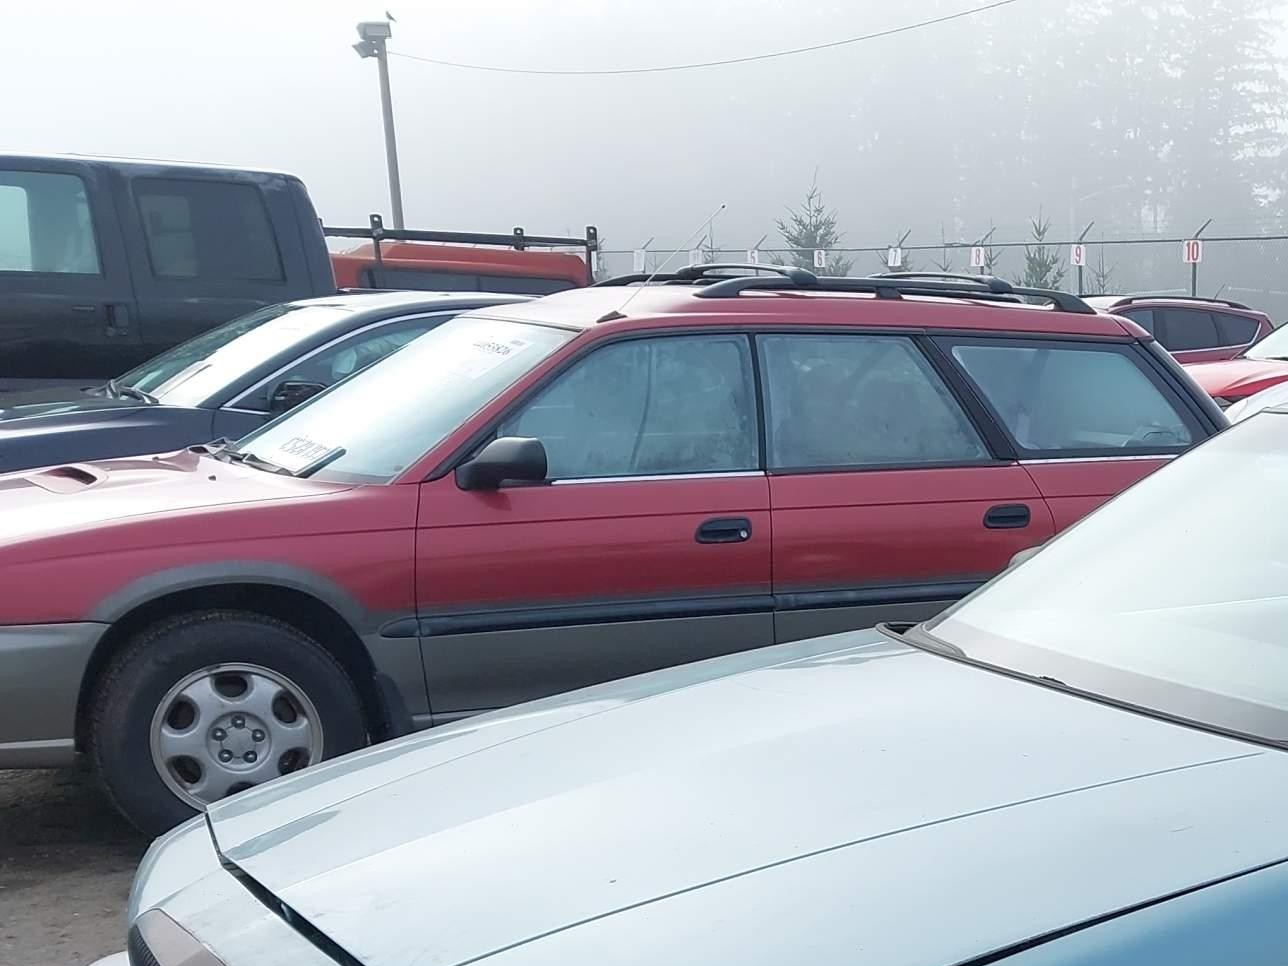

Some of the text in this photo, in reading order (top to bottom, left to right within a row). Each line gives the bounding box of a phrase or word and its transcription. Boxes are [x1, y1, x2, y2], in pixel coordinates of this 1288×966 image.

[816, 250, 823, 267] 6
[975, 248, 981, 266] 8
[1075, 245, 1082, 264] 9
[1186, 241, 1200, 262] 10
